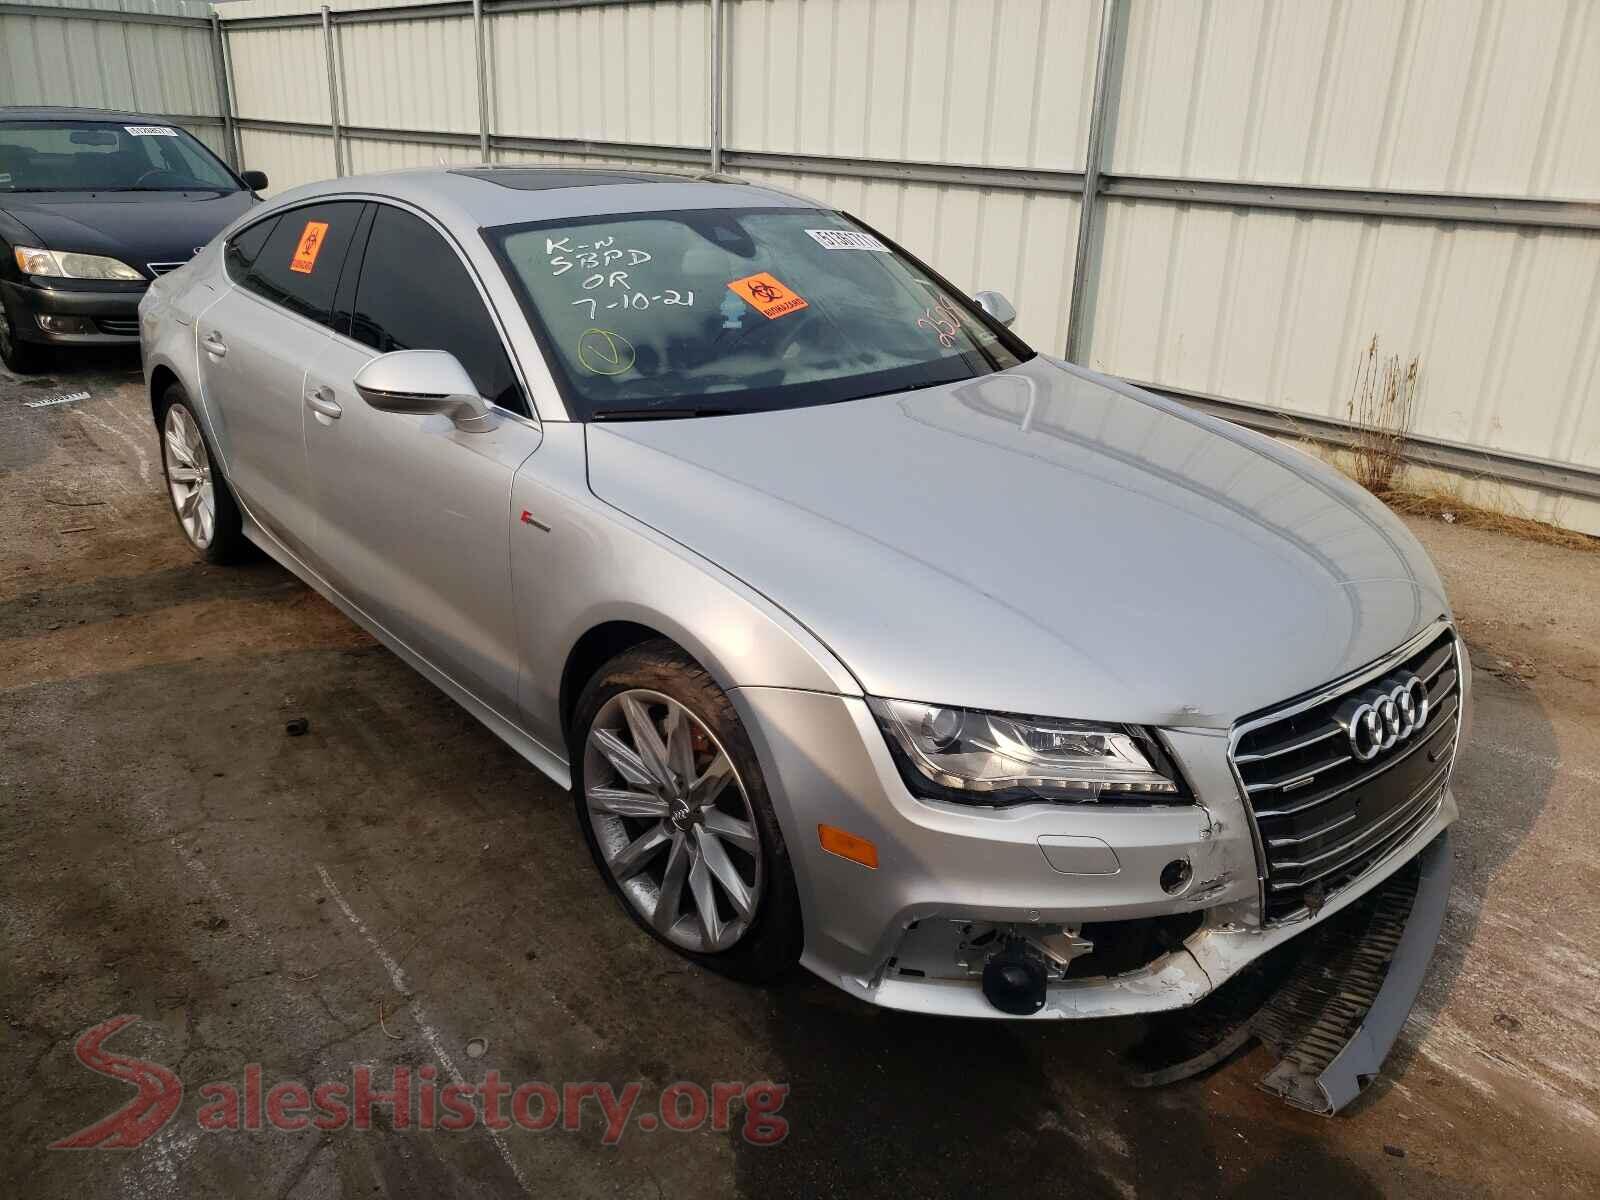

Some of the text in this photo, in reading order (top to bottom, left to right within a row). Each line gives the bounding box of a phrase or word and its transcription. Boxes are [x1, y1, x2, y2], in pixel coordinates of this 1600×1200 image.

[550, 249, 651, 275] SBPD
[582, 271, 631, 289] OR
[572, 290, 693, 319] 7-10-21
